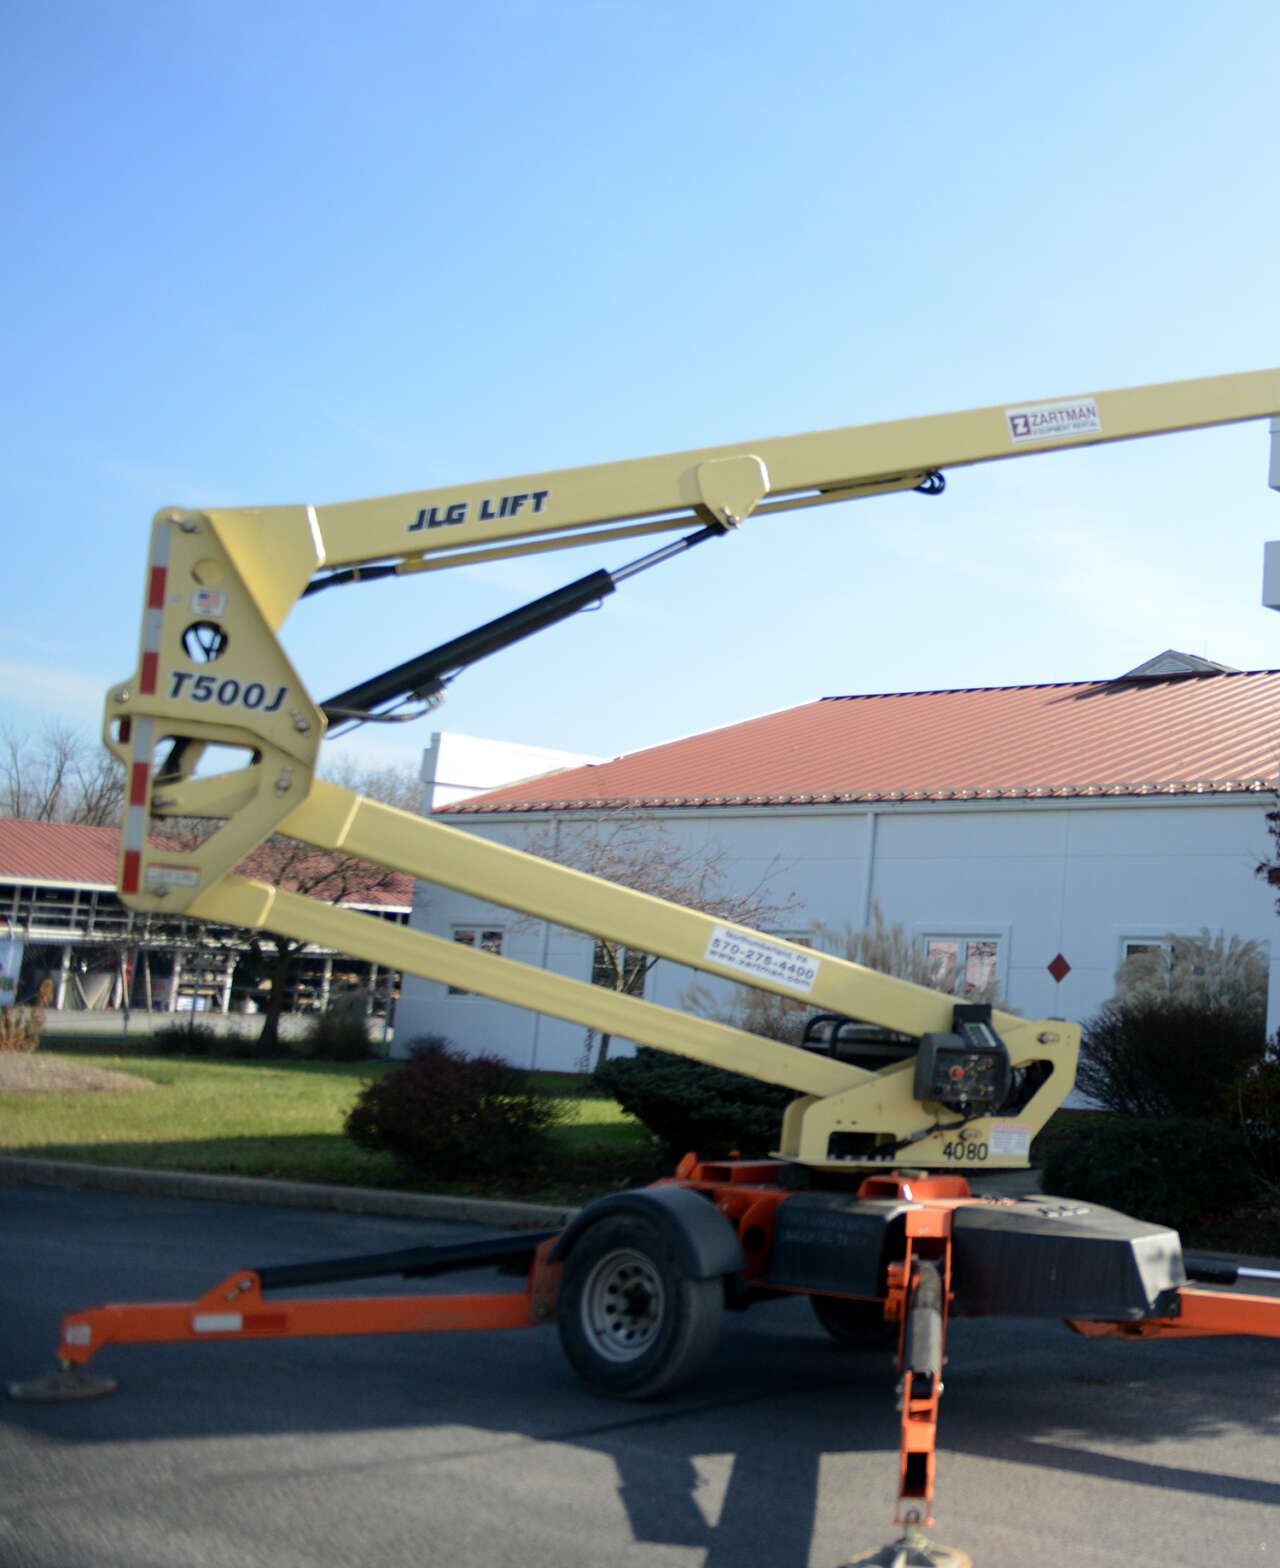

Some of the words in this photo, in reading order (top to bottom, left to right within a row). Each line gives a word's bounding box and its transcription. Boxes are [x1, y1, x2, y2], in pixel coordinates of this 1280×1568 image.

[1030, 407, 1096, 427] ZARTMAN
[408, 503, 467, 532] JLG
[479, 490, 549, 521] LIFT
[169, 671, 289, 712] T500J
[711, 938, 815, 980] 570-275-4400
[943, 1141, 989, 1161] 4080
